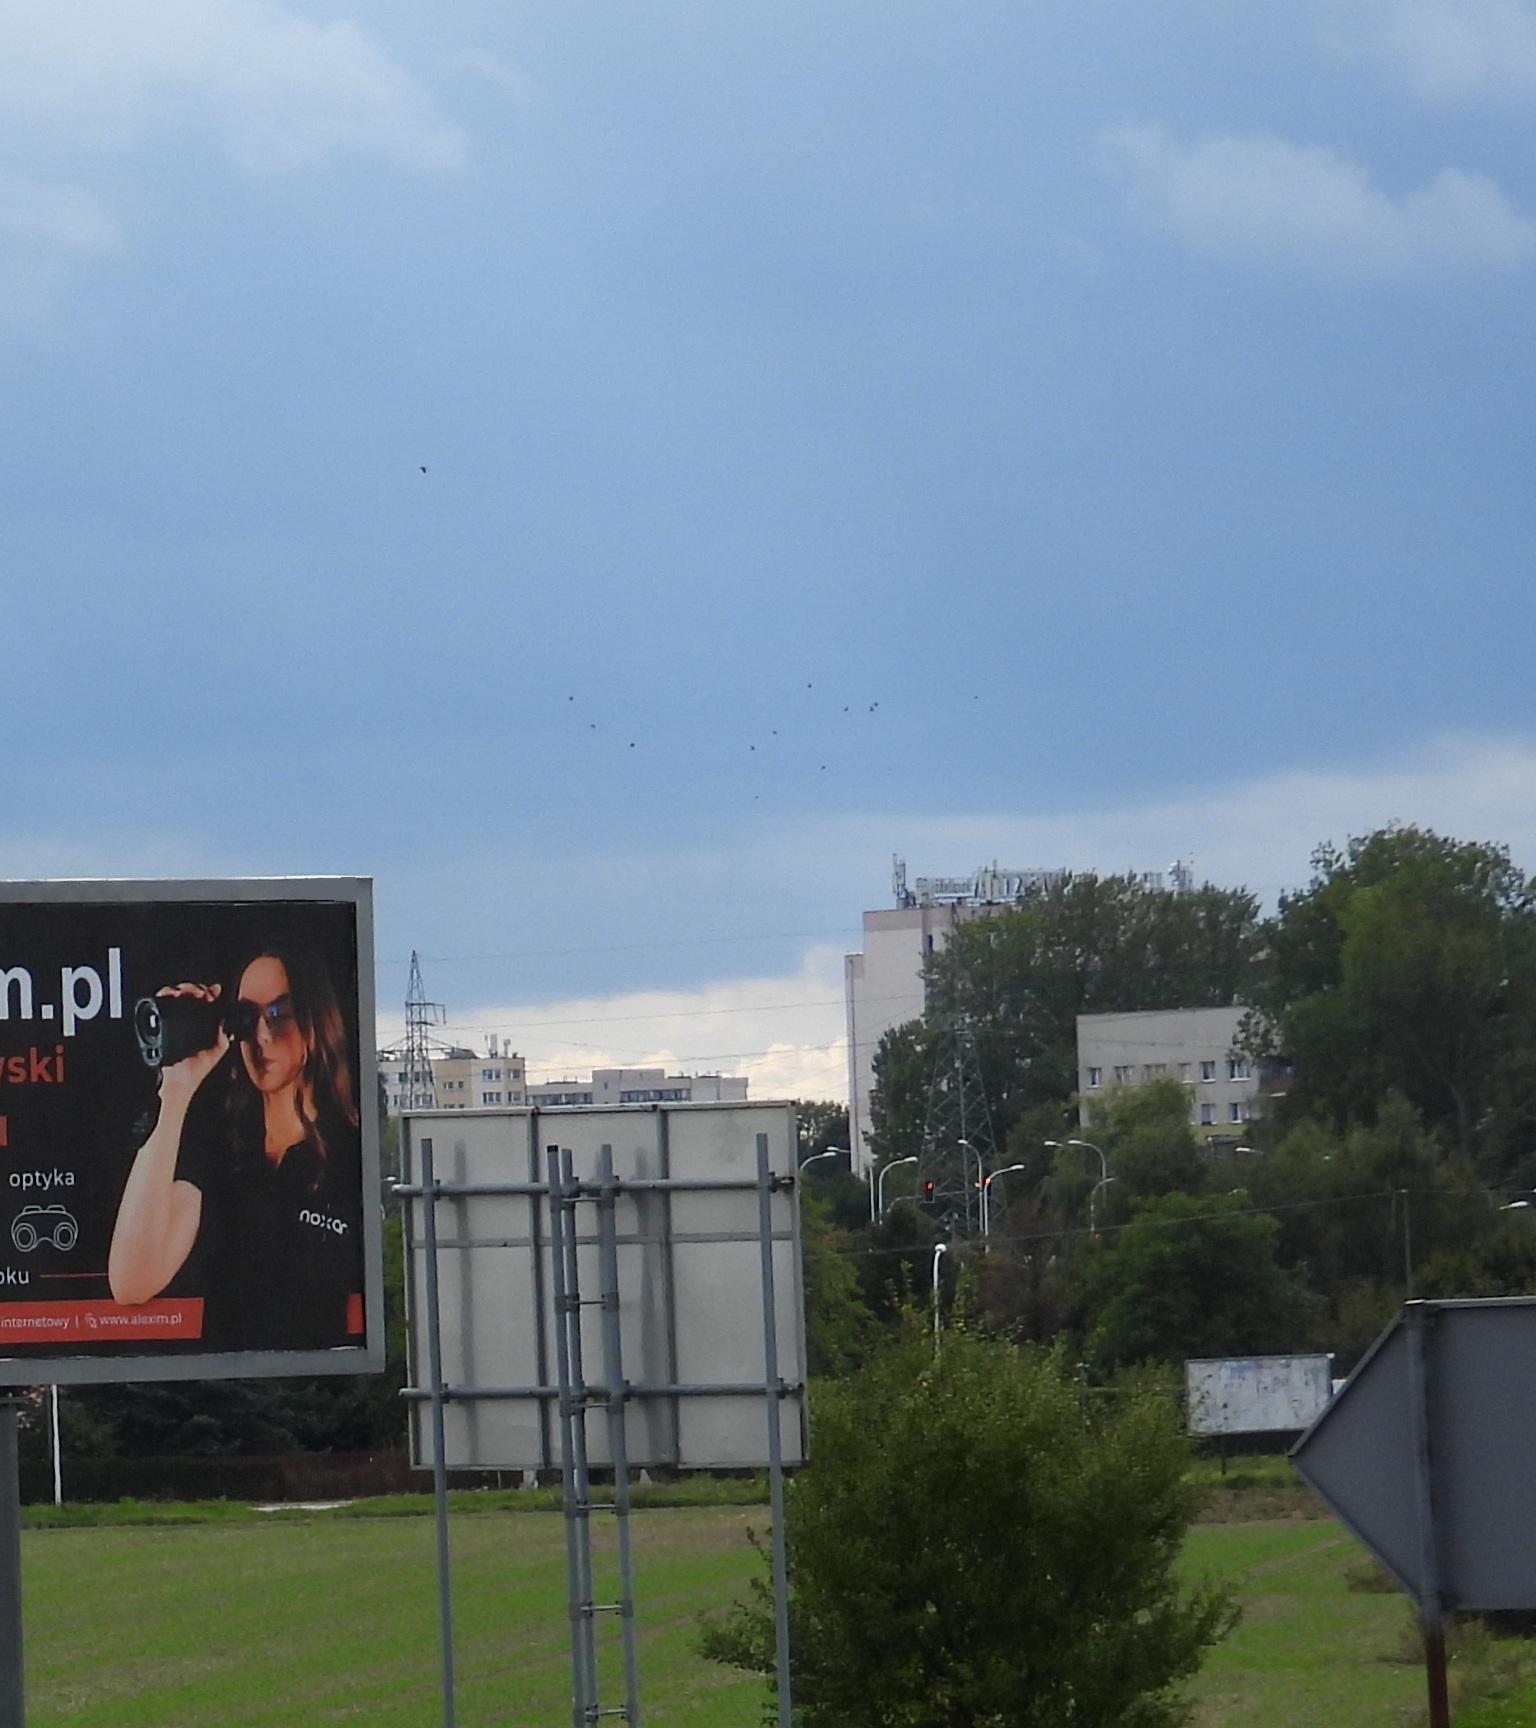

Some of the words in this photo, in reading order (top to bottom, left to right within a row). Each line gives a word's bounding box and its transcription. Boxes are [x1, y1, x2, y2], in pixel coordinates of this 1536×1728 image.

[9, 1169, 75, 1191] optyka
[0, 1314, 70, 1331] internetowy
[98, 1313, 183, 1328] www.alexim.pl
